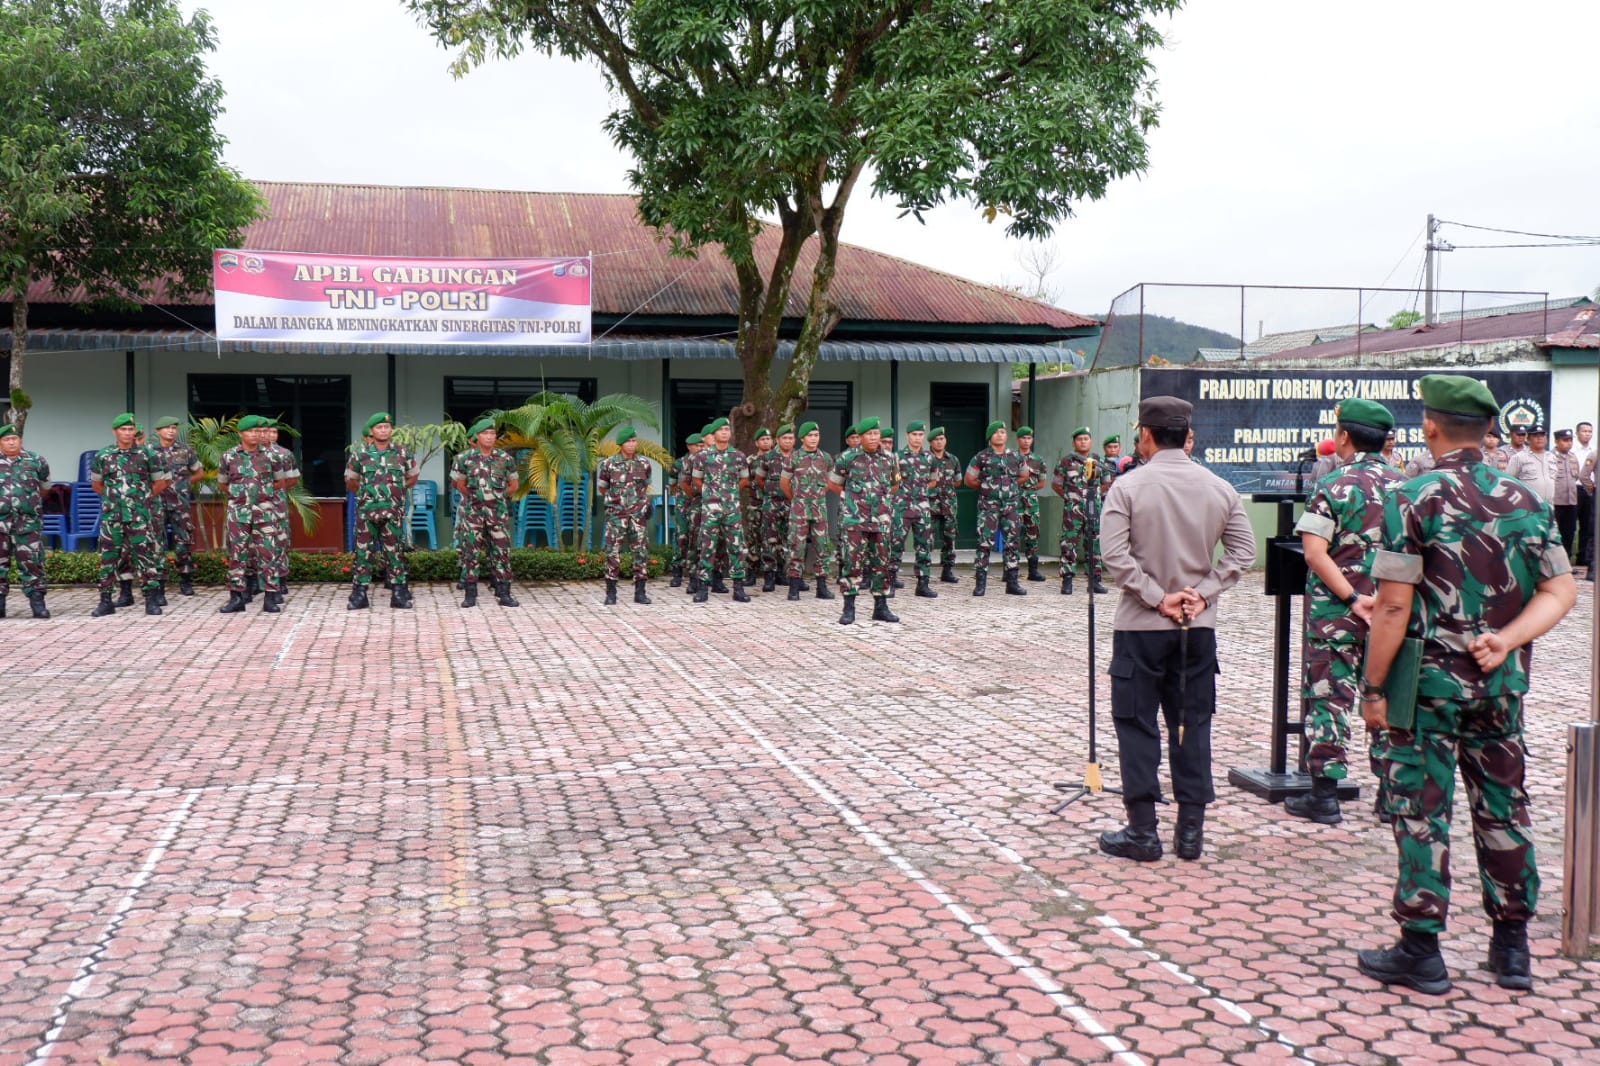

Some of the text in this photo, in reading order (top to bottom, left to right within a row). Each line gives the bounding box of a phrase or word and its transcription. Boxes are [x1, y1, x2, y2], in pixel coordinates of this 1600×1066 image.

[293, 264, 518, 286] APEL GABUNGAN
[324, 288, 376, 309] TNI
[401, 290, 488, 311] POLRI
[233, 315, 582, 333] DALAM RANGKA MENINGKATKAN SINERGITAS TNI-POLRI
[1199, 379, 1270, 400] PRAJURIT
[1272, 379, 1323, 400] KOREM
[1325, 379, 1410, 400] 023/KAWAL
[1233, 428, 1337, 443] PRAJURIT PETA
[1204, 448, 1310, 463] SELALU BERSY
[1265, 479, 1297, 488] PANTAN
